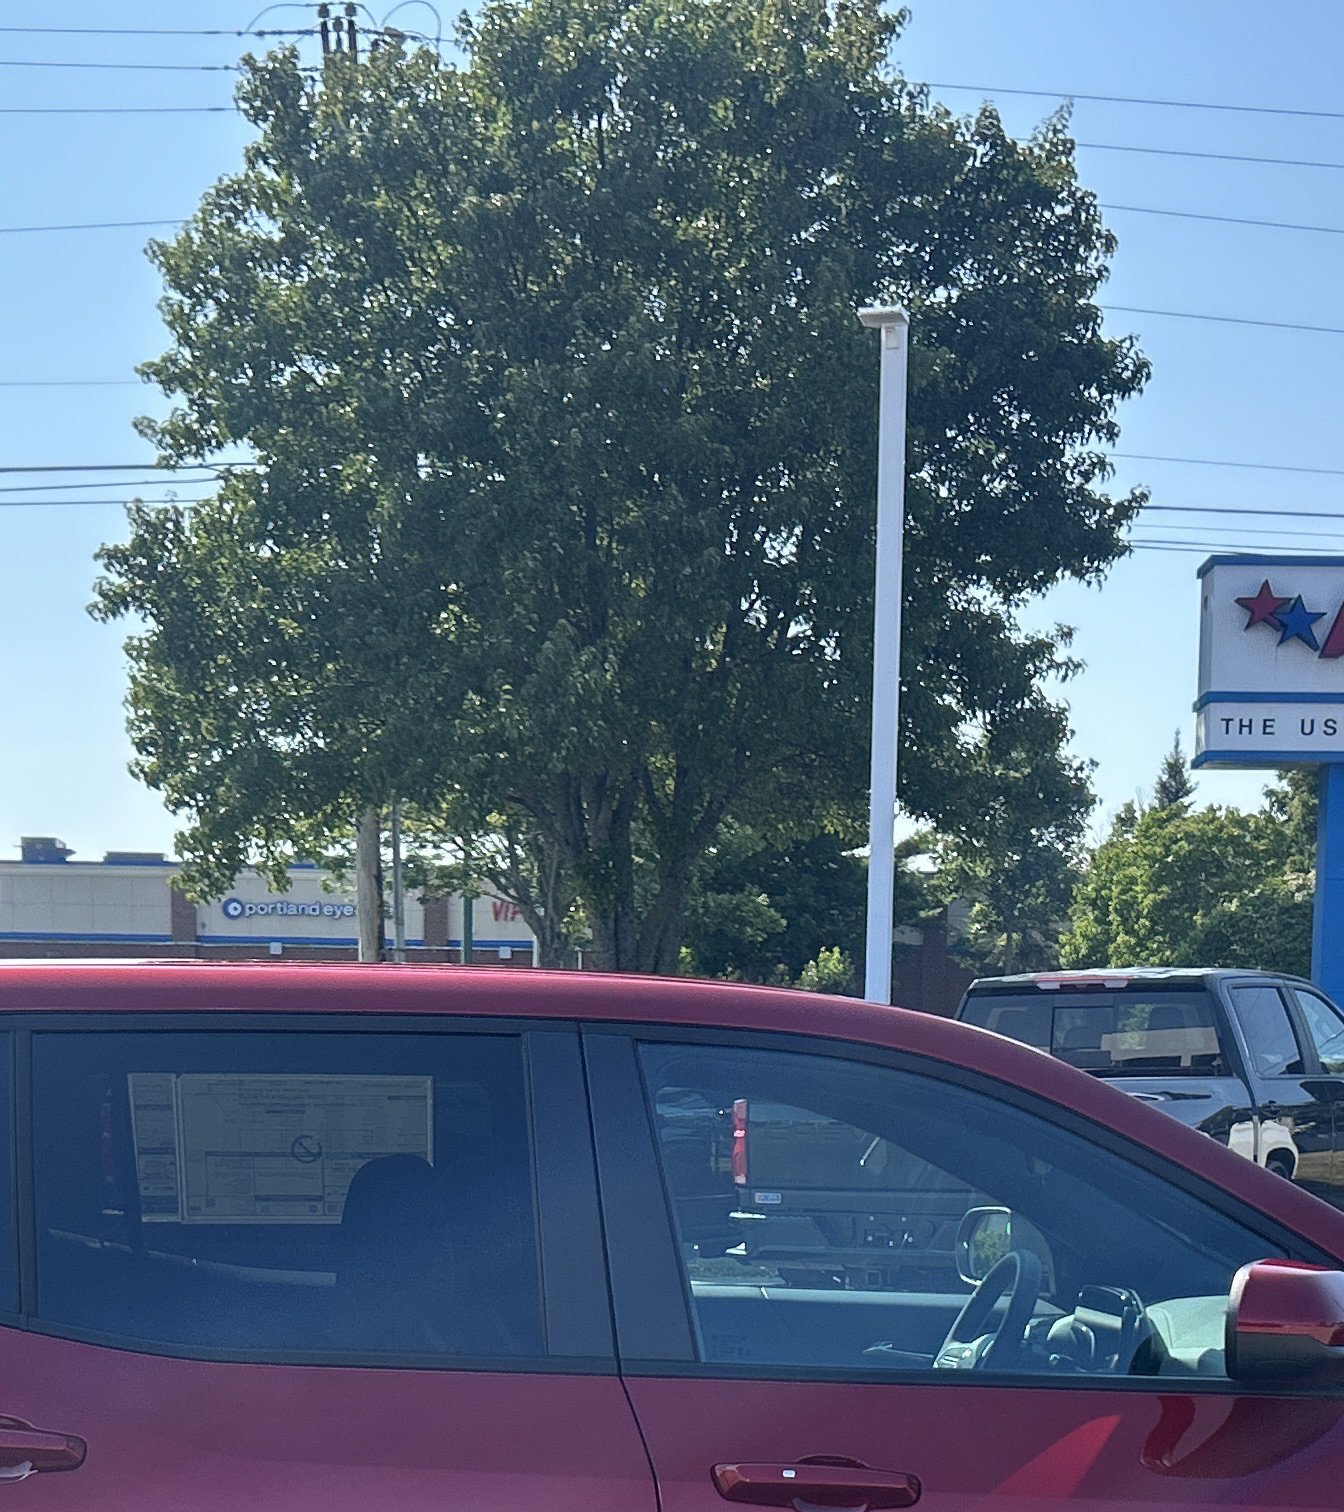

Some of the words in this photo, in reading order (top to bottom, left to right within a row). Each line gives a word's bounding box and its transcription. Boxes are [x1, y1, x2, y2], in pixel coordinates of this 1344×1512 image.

[1220, 717, 1276, 736] THE
[244, 900, 321, 918] portland
[322, 903, 355, 920] eye
